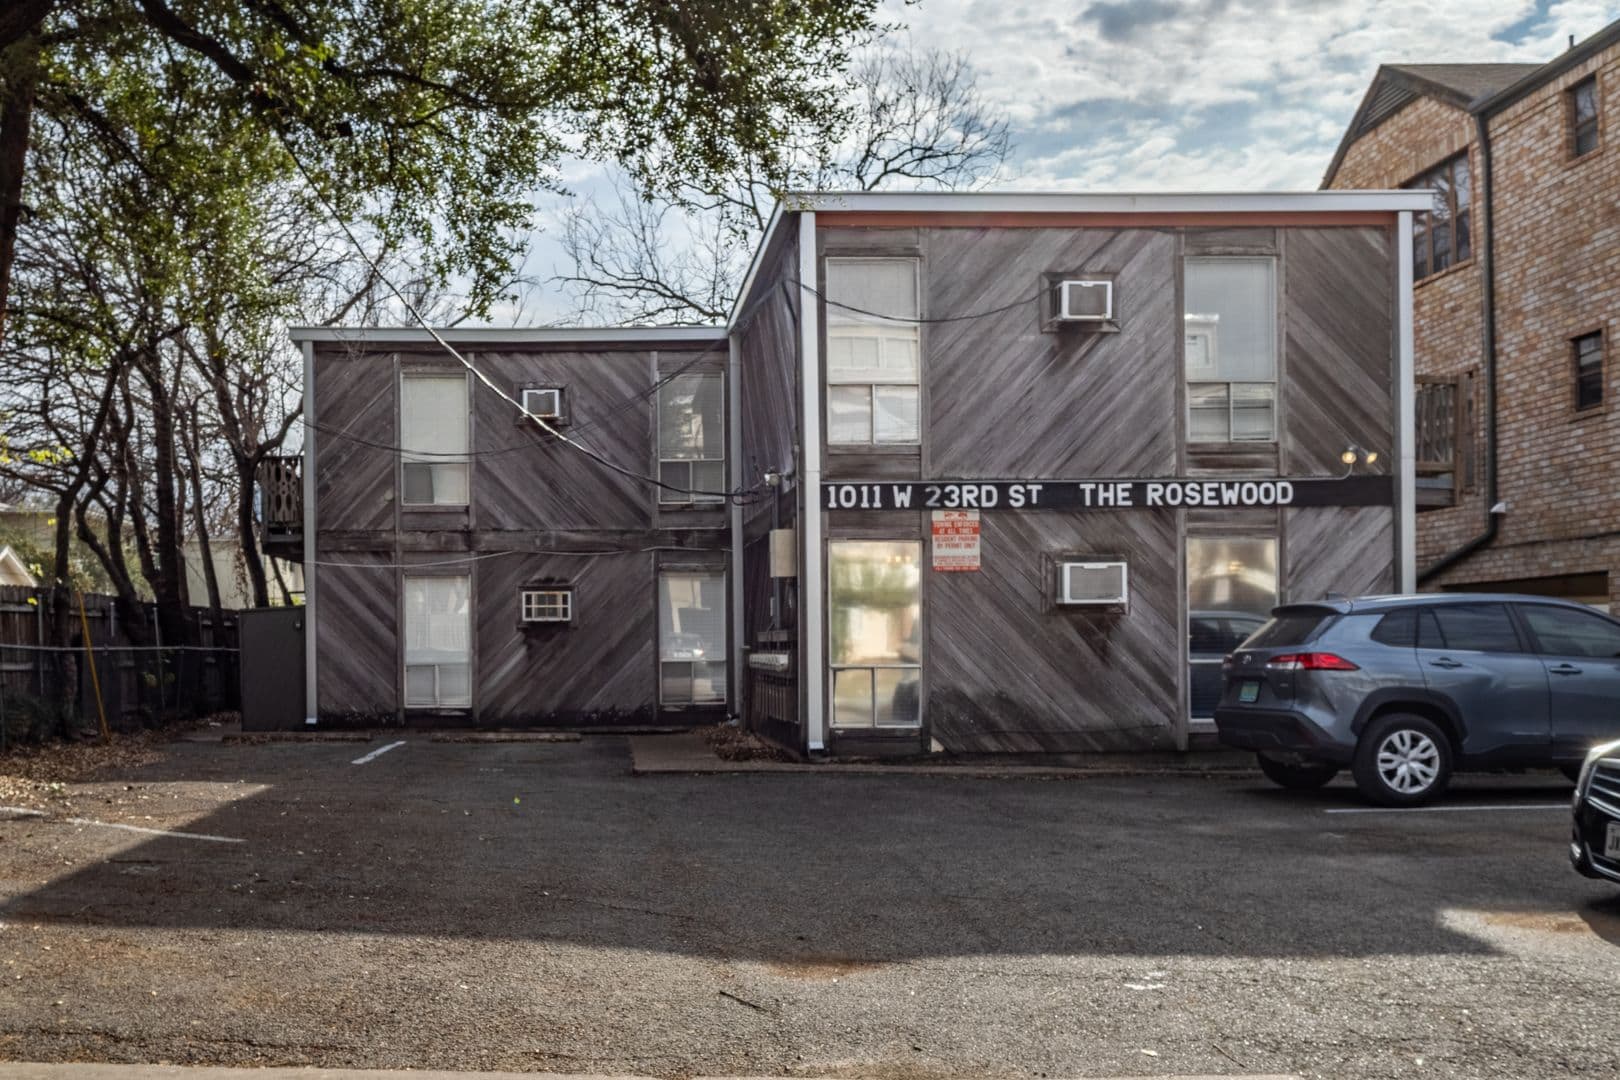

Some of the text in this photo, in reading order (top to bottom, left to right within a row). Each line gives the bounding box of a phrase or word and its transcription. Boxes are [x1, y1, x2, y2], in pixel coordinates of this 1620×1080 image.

[828, 482, 1294, 508] 1011 W 23RD ST THE ROSEWOOD
